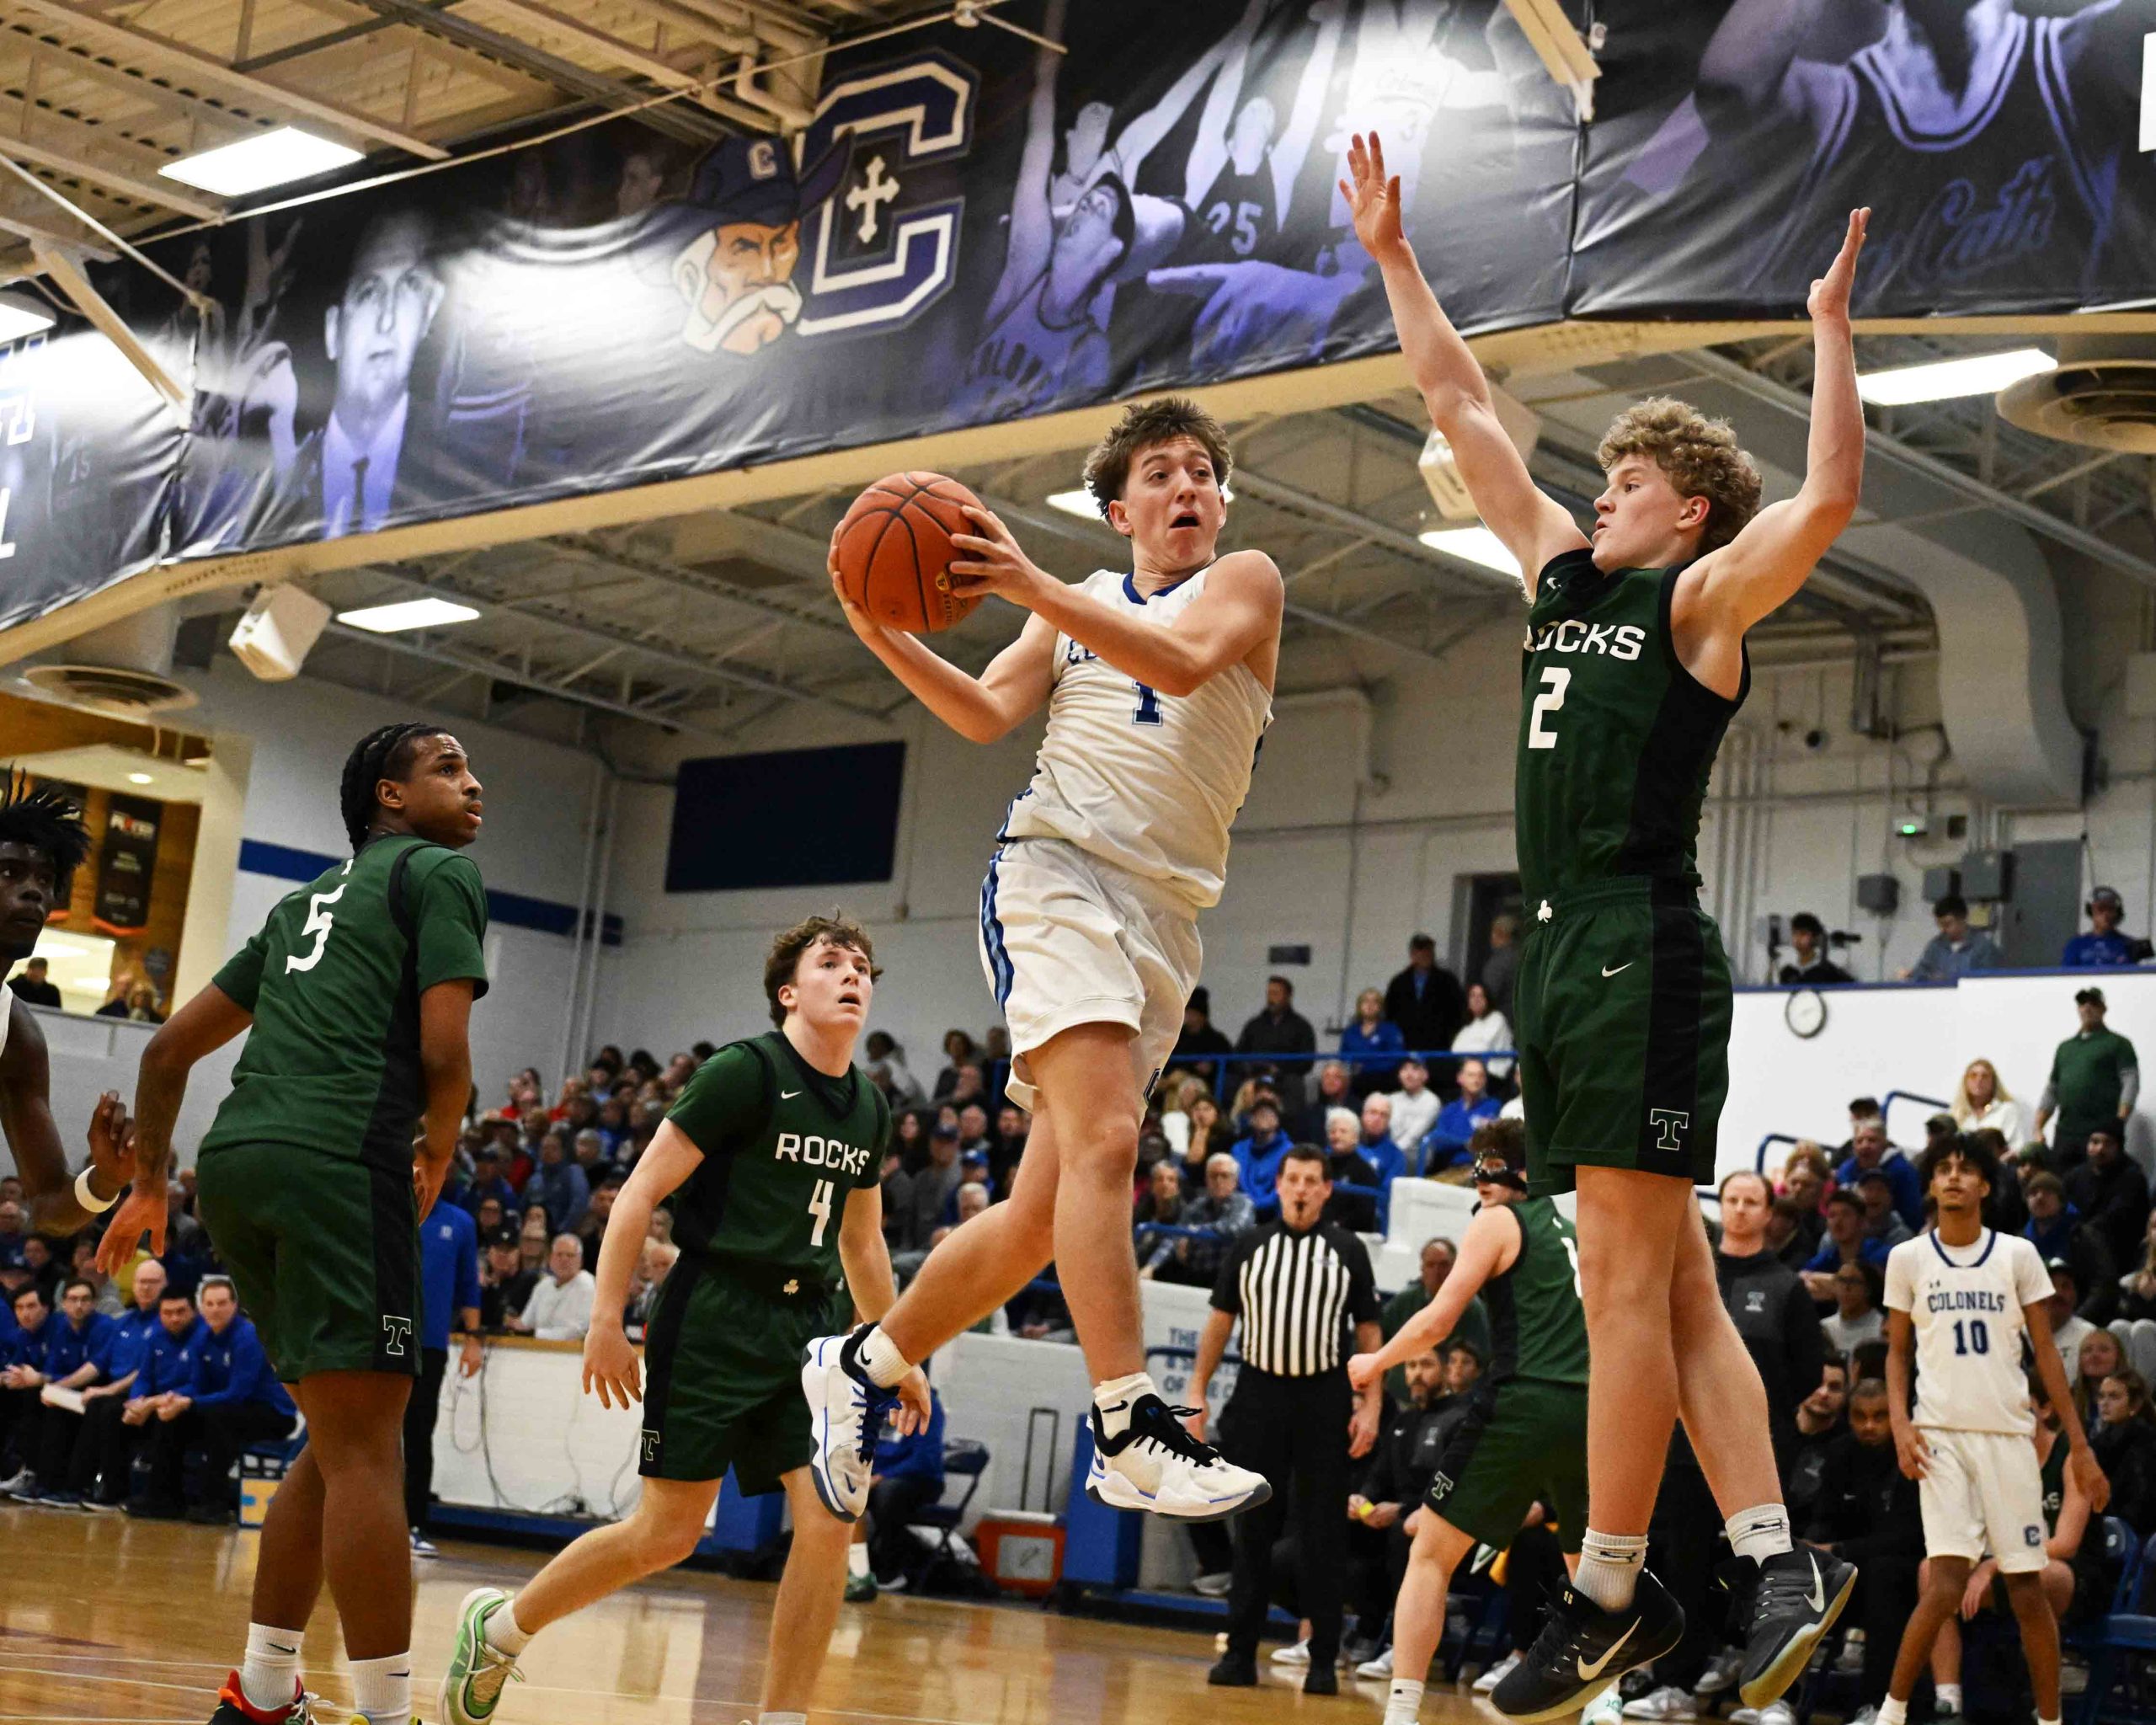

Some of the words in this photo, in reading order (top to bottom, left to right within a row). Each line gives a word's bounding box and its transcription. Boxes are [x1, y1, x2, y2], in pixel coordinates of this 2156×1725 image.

[748, 139, 777, 179] C
[793, 52, 977, 339] C
[1205, 201, 1262, 255] 25
[1131, 681, 1164, 727] 1
[1529, 667, 1572, 749] 2
[285, 883, 347, 974] 5
[1650, 1108, 1689, 1151] T
[775, 1133, 871, 1176] ROCKS
[808, 1178, 835, 1247] 4
[1927, 1291, 2005, 1313] COLONELS
[383, 1315, 411, 1355] T
[1952, 1319, 1989, 1356] 10
[642, 1429, 660, 1461] T
[1433, 1471, 1454, 1500] T
